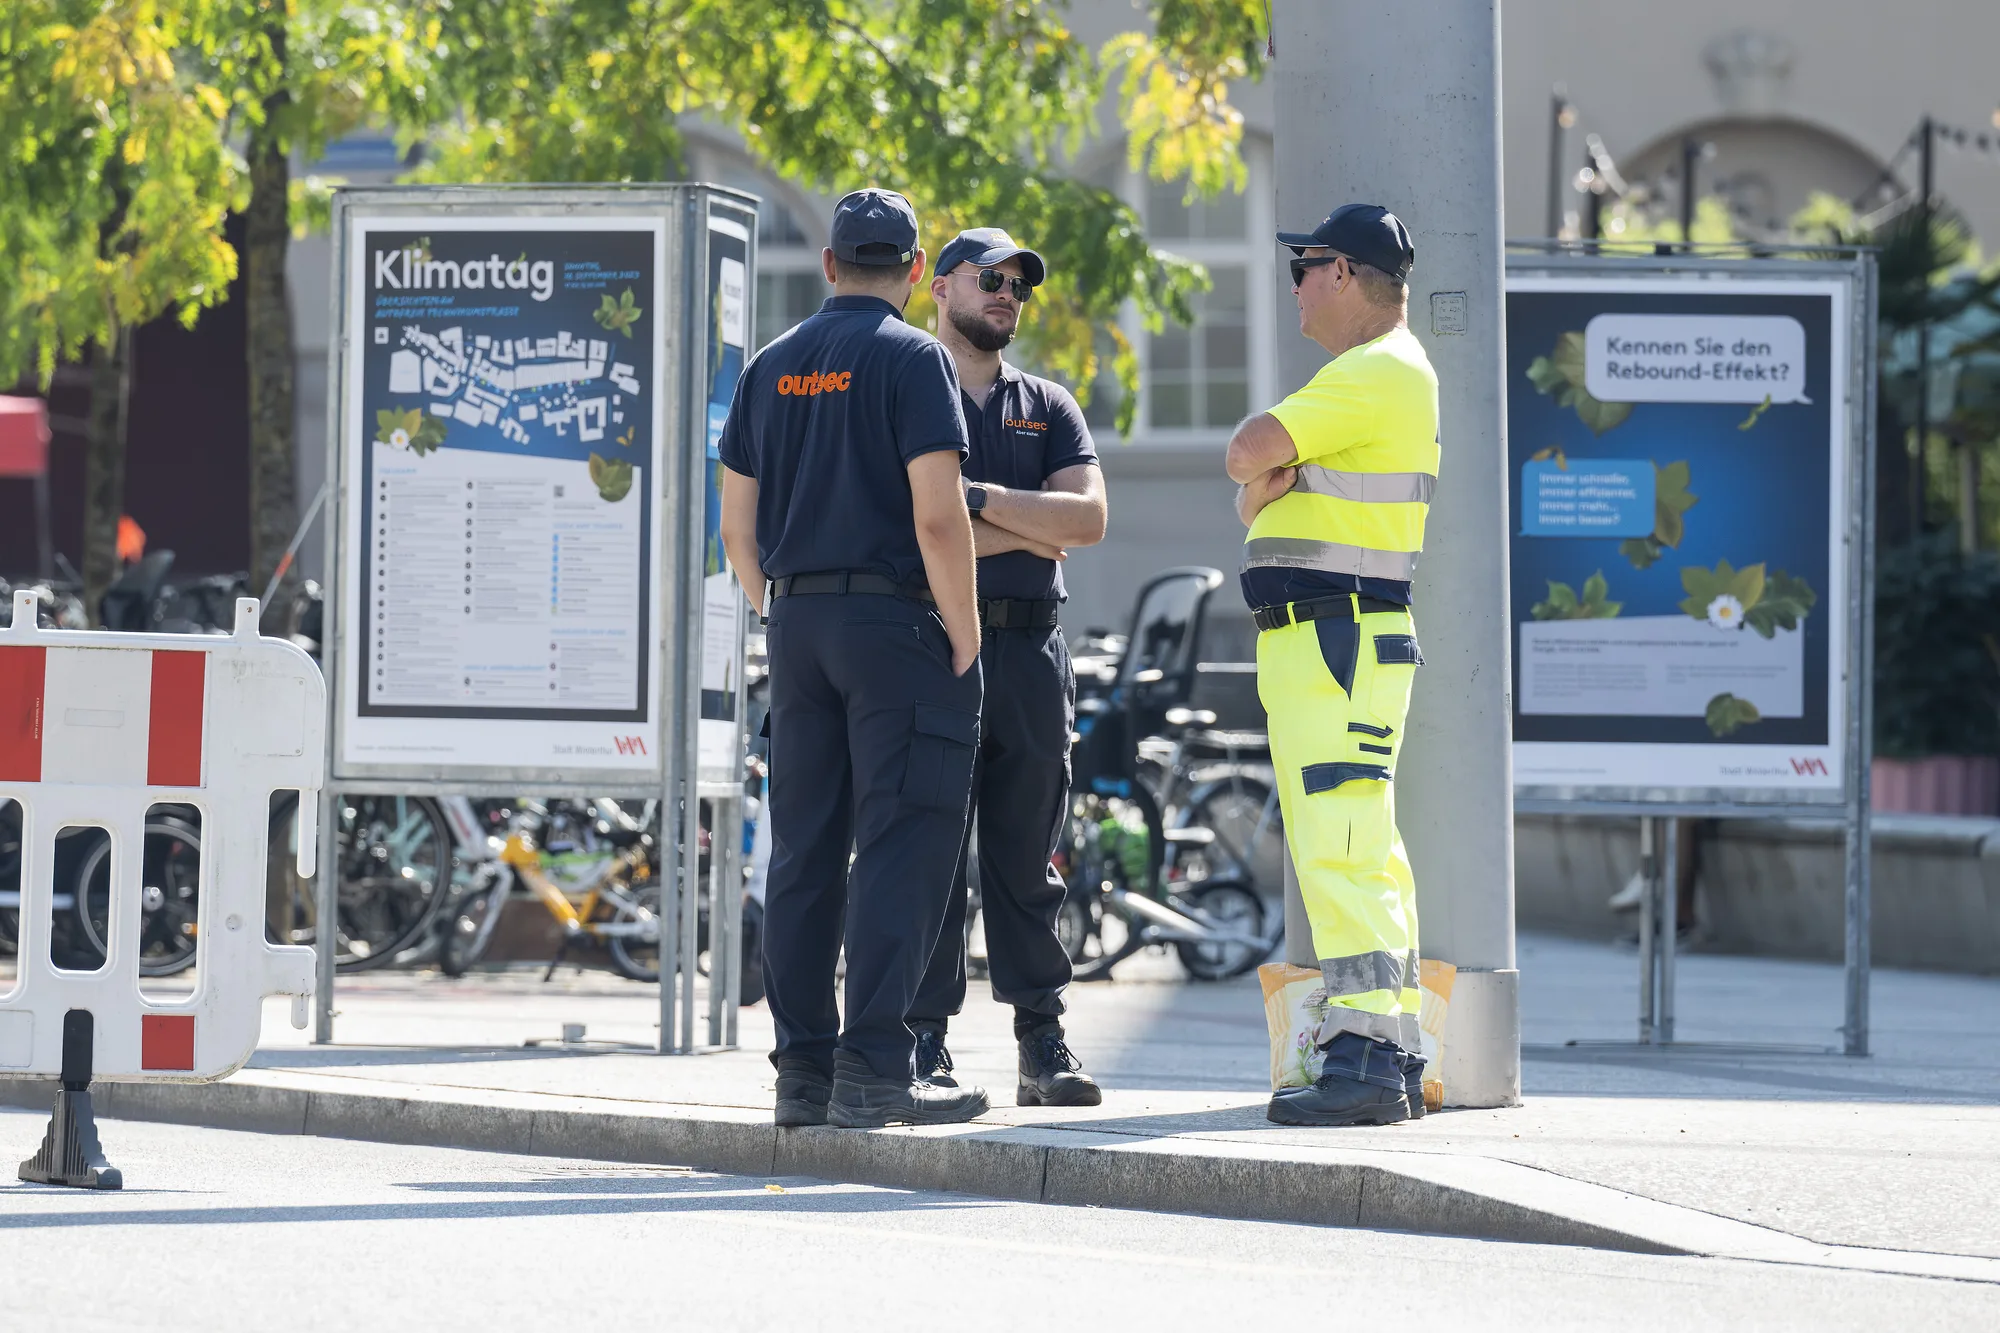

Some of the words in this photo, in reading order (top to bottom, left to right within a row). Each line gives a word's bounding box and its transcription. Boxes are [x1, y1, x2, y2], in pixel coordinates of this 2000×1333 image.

[374, 248, 554, 301] Klimatag
[1606, 337, 1688, 356] Kennen
[1694, 337, 1725, 356] Sie
[1731, 338, 1772, 356] den
[1606, 361, 1790, 381] Rebound-Effekt?
[777, 370, 852, 396] outsec
[1005, 419, 1048, 431] outsec
